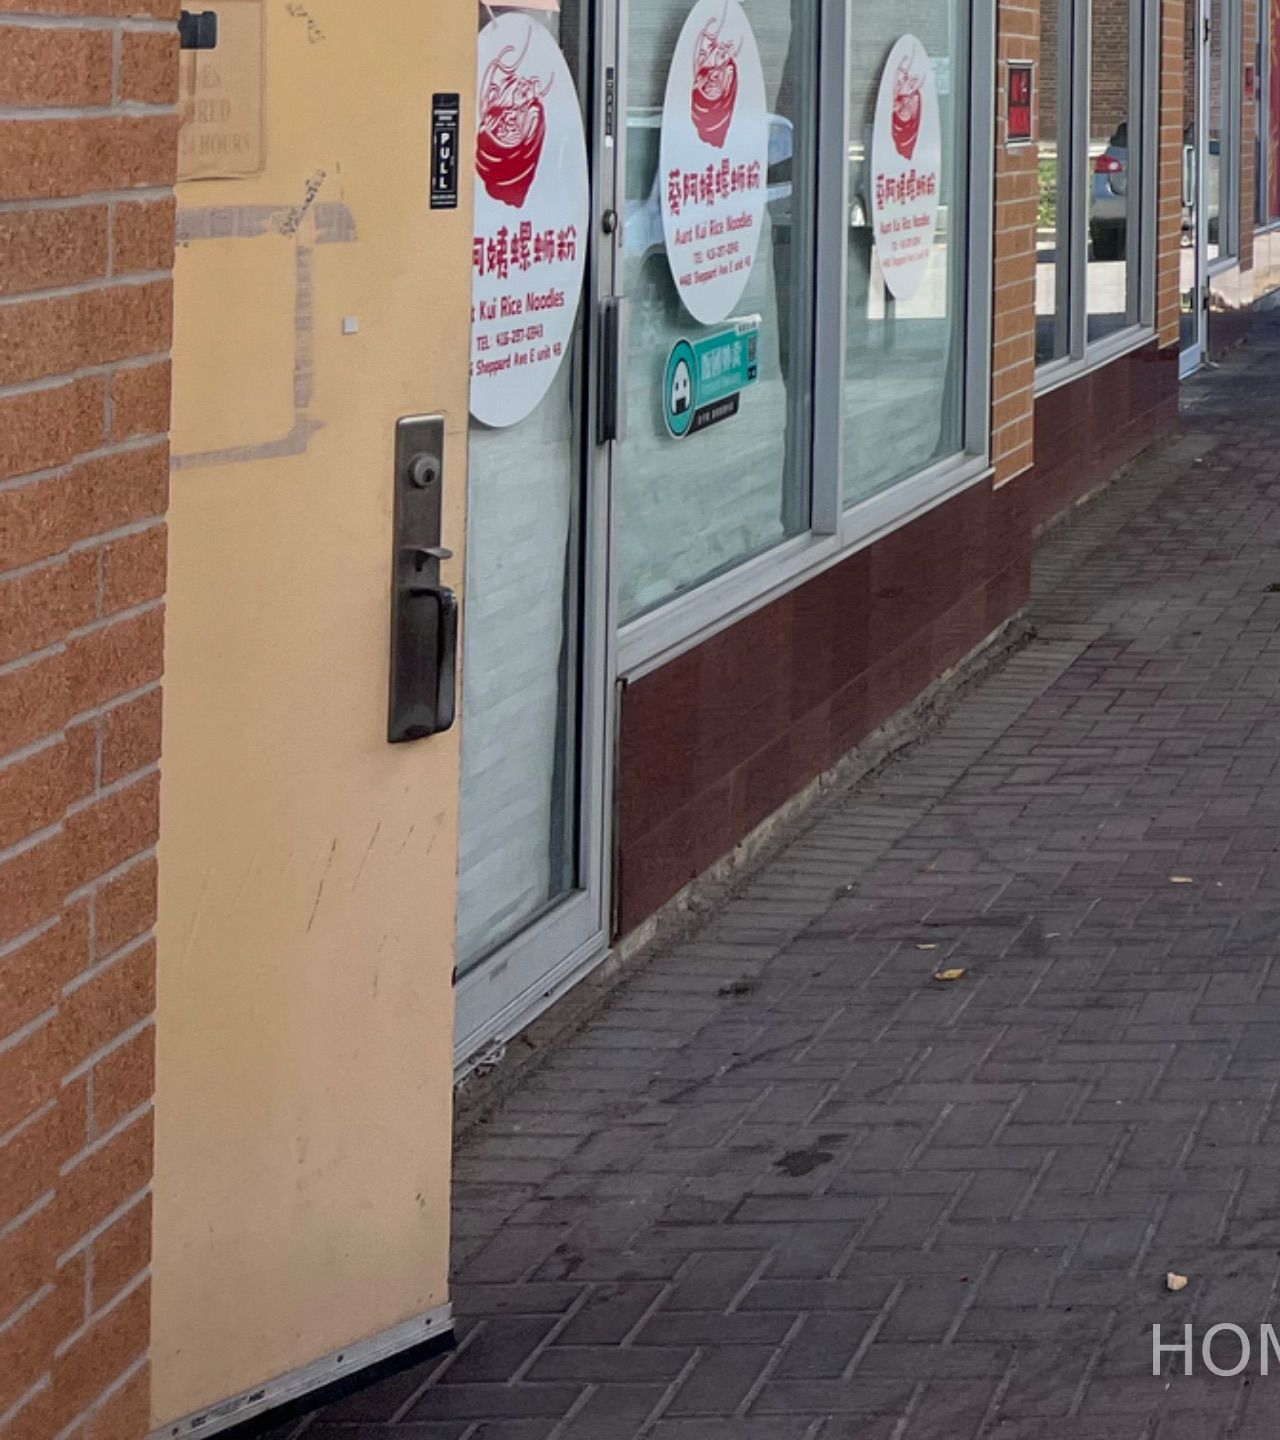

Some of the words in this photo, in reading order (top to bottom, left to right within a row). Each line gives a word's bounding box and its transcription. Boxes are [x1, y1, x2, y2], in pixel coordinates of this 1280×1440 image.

[439, 132, 451, 189] PULL
[675, 228, 692, 245] Aunt
[695, 221, 707, 240] Kui
[710, 218, 724, 236] Rice
[726, 210, 752, 232] Noodles
[479, 297, 497, 322] Kui
[501, 294, 523, 318] Rice
[526, 287, 565, 313] Noodles
[476, 353, 511, 378] Sheppard
[529, 348, 535, 363] E
[537, 344, 551, 360] unit
